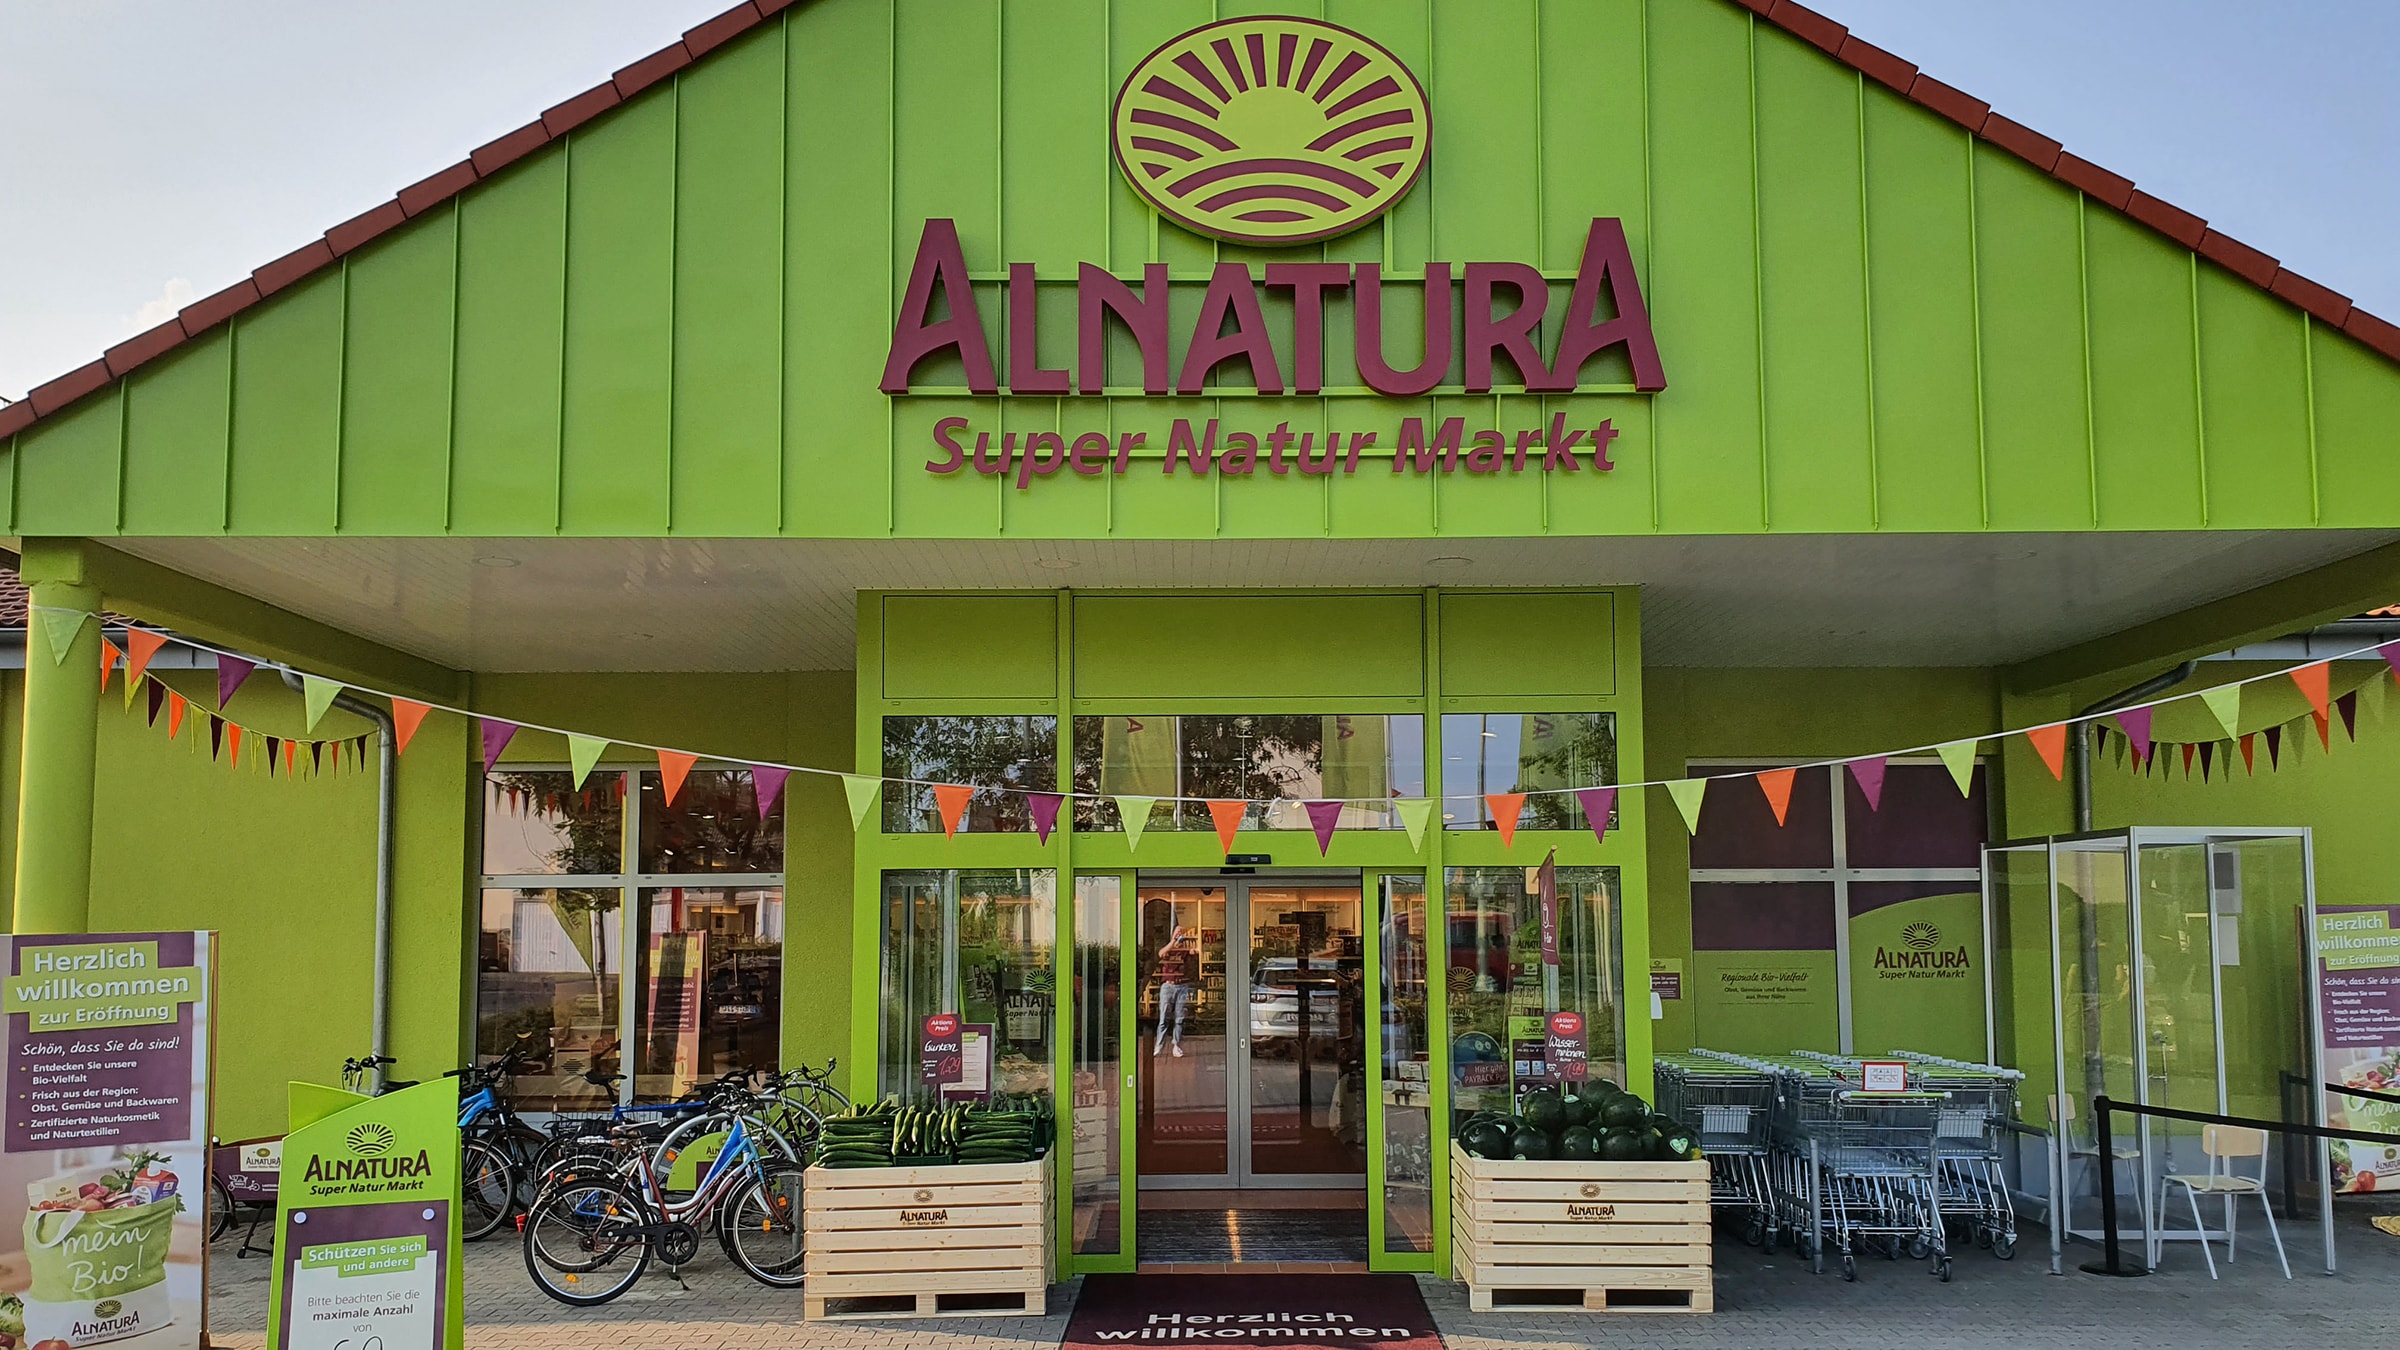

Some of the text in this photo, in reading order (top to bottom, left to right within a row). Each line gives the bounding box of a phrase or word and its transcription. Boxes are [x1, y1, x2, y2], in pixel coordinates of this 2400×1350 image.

[878, 217, 1668, 397] ALNATURA
[925, 411, 1619, 490] Super Natur Markt
[2323, 915, 2383, 931] Herzlich
[2317, 935, 2400, 950] willkomme
[34, 947, 145, 973] Herzlich
[1874, 946, 1970, 969] ALNATURA
[2331, 957, 2347, 966] zur
[1721, 973, 1809, 985] Regionale Bio-Vielfalt
[1879, 970, 1965, 980] Super Natur Markt
[2324, 977, 2349, 987] Schön,
[2349, 977, 2365, 985] dass
[2367, 977, 2378, 985] Sie
[2379, 976, 2389, 984] da
[16, 976, 190, 1001] willkommen
[39, 1006, 169, 1025] zur Eröffnung
[21, 1036, 180, 1057] Schön, dass Sie da sind!
[33, 1060, 137, 1073] Entdecken Sie unsere
[32, 1074, 87, 1085] Bio-Vielfalt
[32, 1086, 139, 1101] Frisch aus der Region:
[31, 1096, 179, 1113] Obst, Gemüse und Backwaren
[30, 1112, 161, 1129] Zertifizierte Naturkosmetik
[30, 1127, 120, 1141] und Naturtextilien
[304, 1150, 432, 1182] ALNATURA
[310, 1180, 424, 1197] Super Natur Markt
[900, 1209, 948, 1222] ALNATURA
[1567, 1204, 1615, 1216] ALNATURA
[62, 1219, 151, 1257] mein
[308, 1242, 422, 1263] Schützen Sie sich
[343, 1258, 410, 1273] und andere
[307, 1289, 421, 1307] Bitte beachten Sie die
[312, 1304, 414, 1321] maximale Anzahl
[1147, 1312, 1355, 1325] Herzlich
[71, 1311, 140, 1336] ALNATURA
[353, 1324, 372, 1333] von
[1095, 1325, 1411, 1340] willkommen
